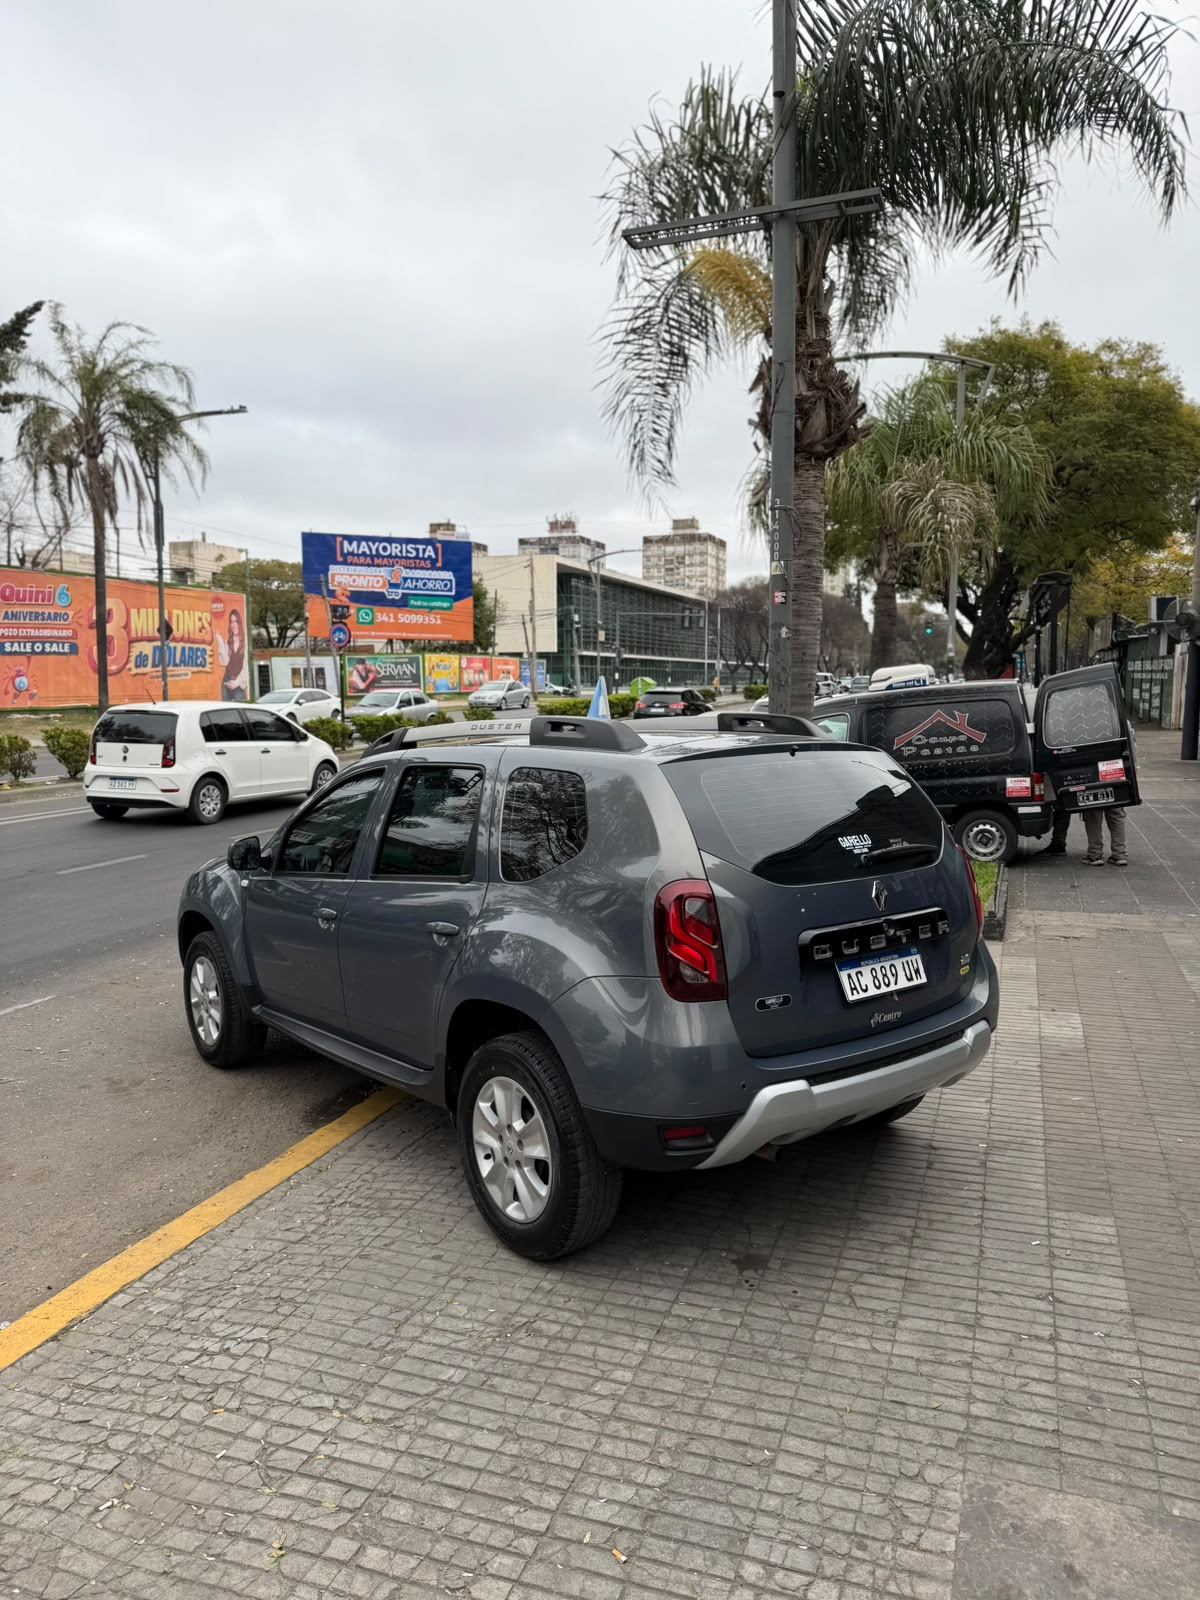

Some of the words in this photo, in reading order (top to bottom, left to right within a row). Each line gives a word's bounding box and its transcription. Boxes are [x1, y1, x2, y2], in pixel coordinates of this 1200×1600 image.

[342, 540, 436, 559] MAYORISTA
[347, 555, 372, 565] PARA
[374, 557, 432, 569] MAYORISTAS
[333, 574, 384, 588] PRONTO
[403, 578, 451, 591] AHORRO
[0, 583, 54, 606] Quini
[56, 583, 72, 608] 6
[3, 610, 69, 622] ANIVERSARIO
[375, 613, 395, 623] 341
[397, 614, 441, 625] 5099351
[19, 629, 73, 637] EXTRAORDINARIO
[4, 642, 32, 652] SALE
[34, 643, 42, 652] O
[44, 643, 70, 653] SALE
[134, 651, 149, 669] de
[376, 662, 416, 678] SERVIAN
[471, 723, 522, 731] DUSTER
[838, 834, 872, 848] GARELLO
[813, 920, 950, 961] DUSTER
[847, 970, 869, 996] AC
[870, 963, 898, 990] 889
[901, 957, 922, 983] UW
